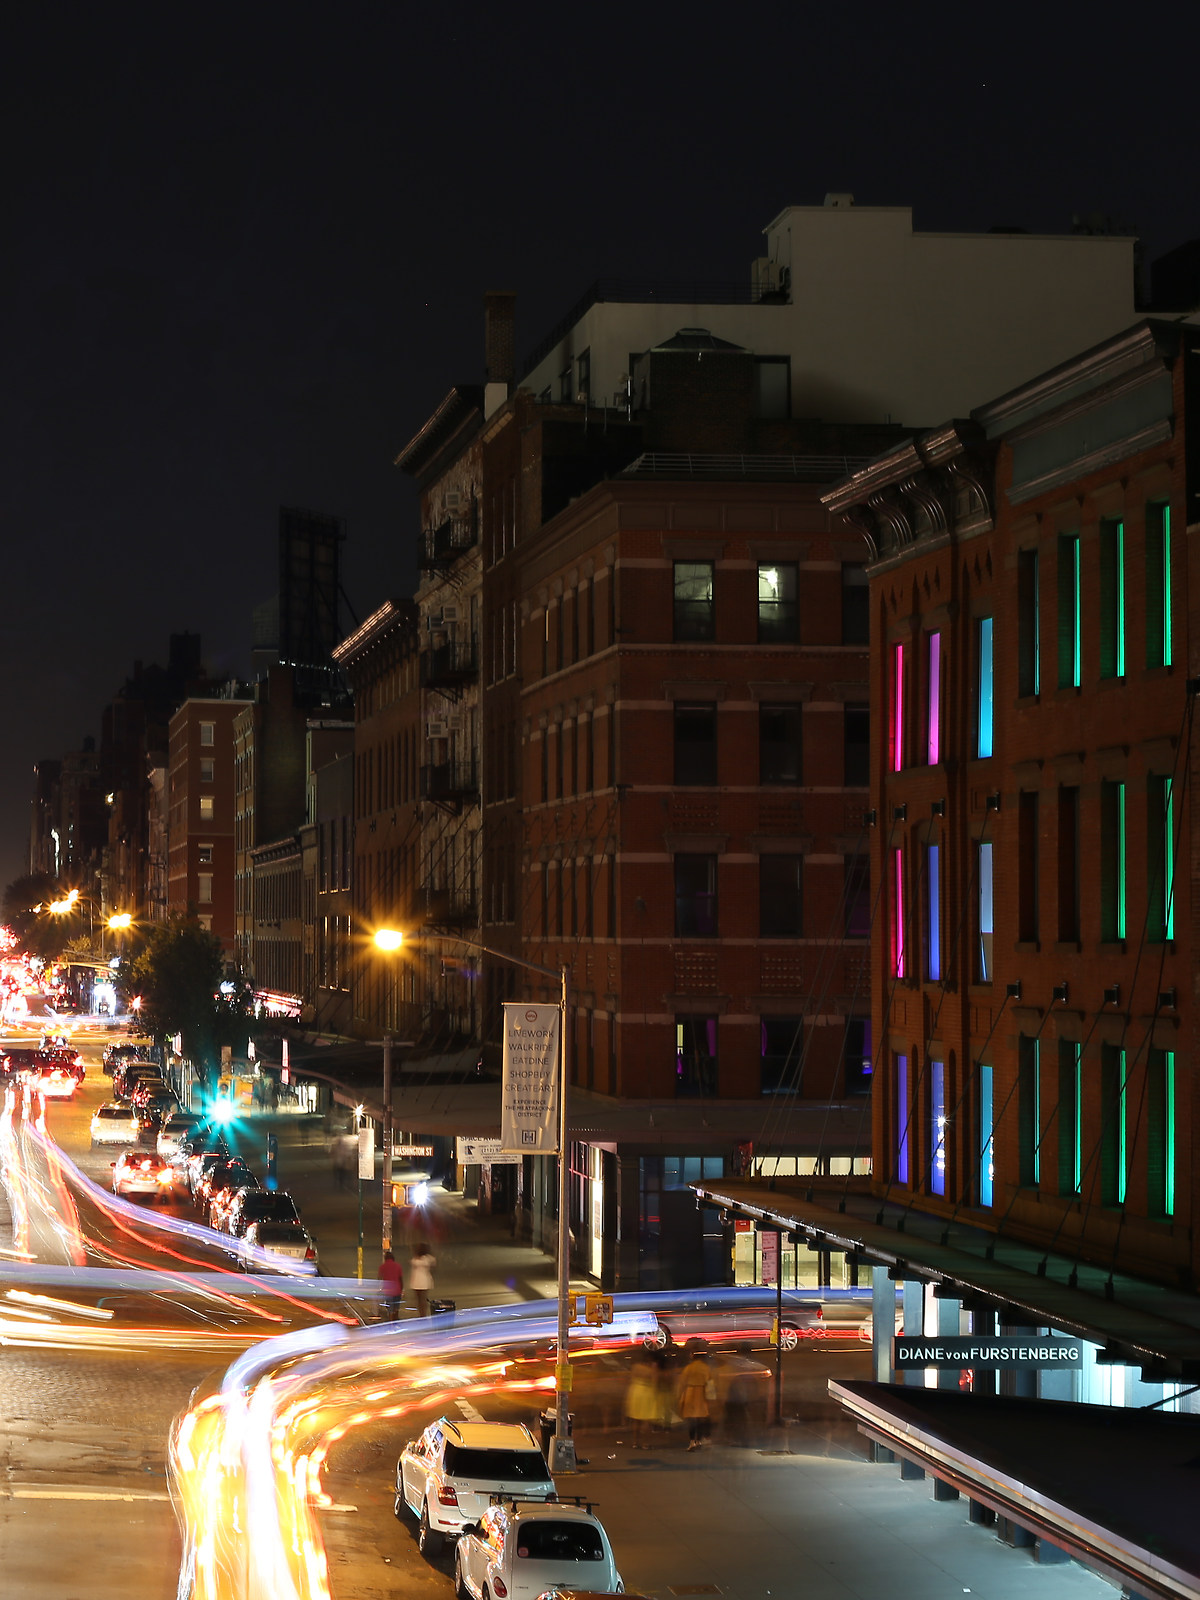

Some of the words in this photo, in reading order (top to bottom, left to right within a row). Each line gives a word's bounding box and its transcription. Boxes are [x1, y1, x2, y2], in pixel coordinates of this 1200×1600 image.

[394, 1147, 425, 1156] WASHINGTON
[426, 1147, 433, 1156] ST
[899, 1348, 944, 1360] DIANE
[970, 1348, 1079, 1360] FURSTENBERG
